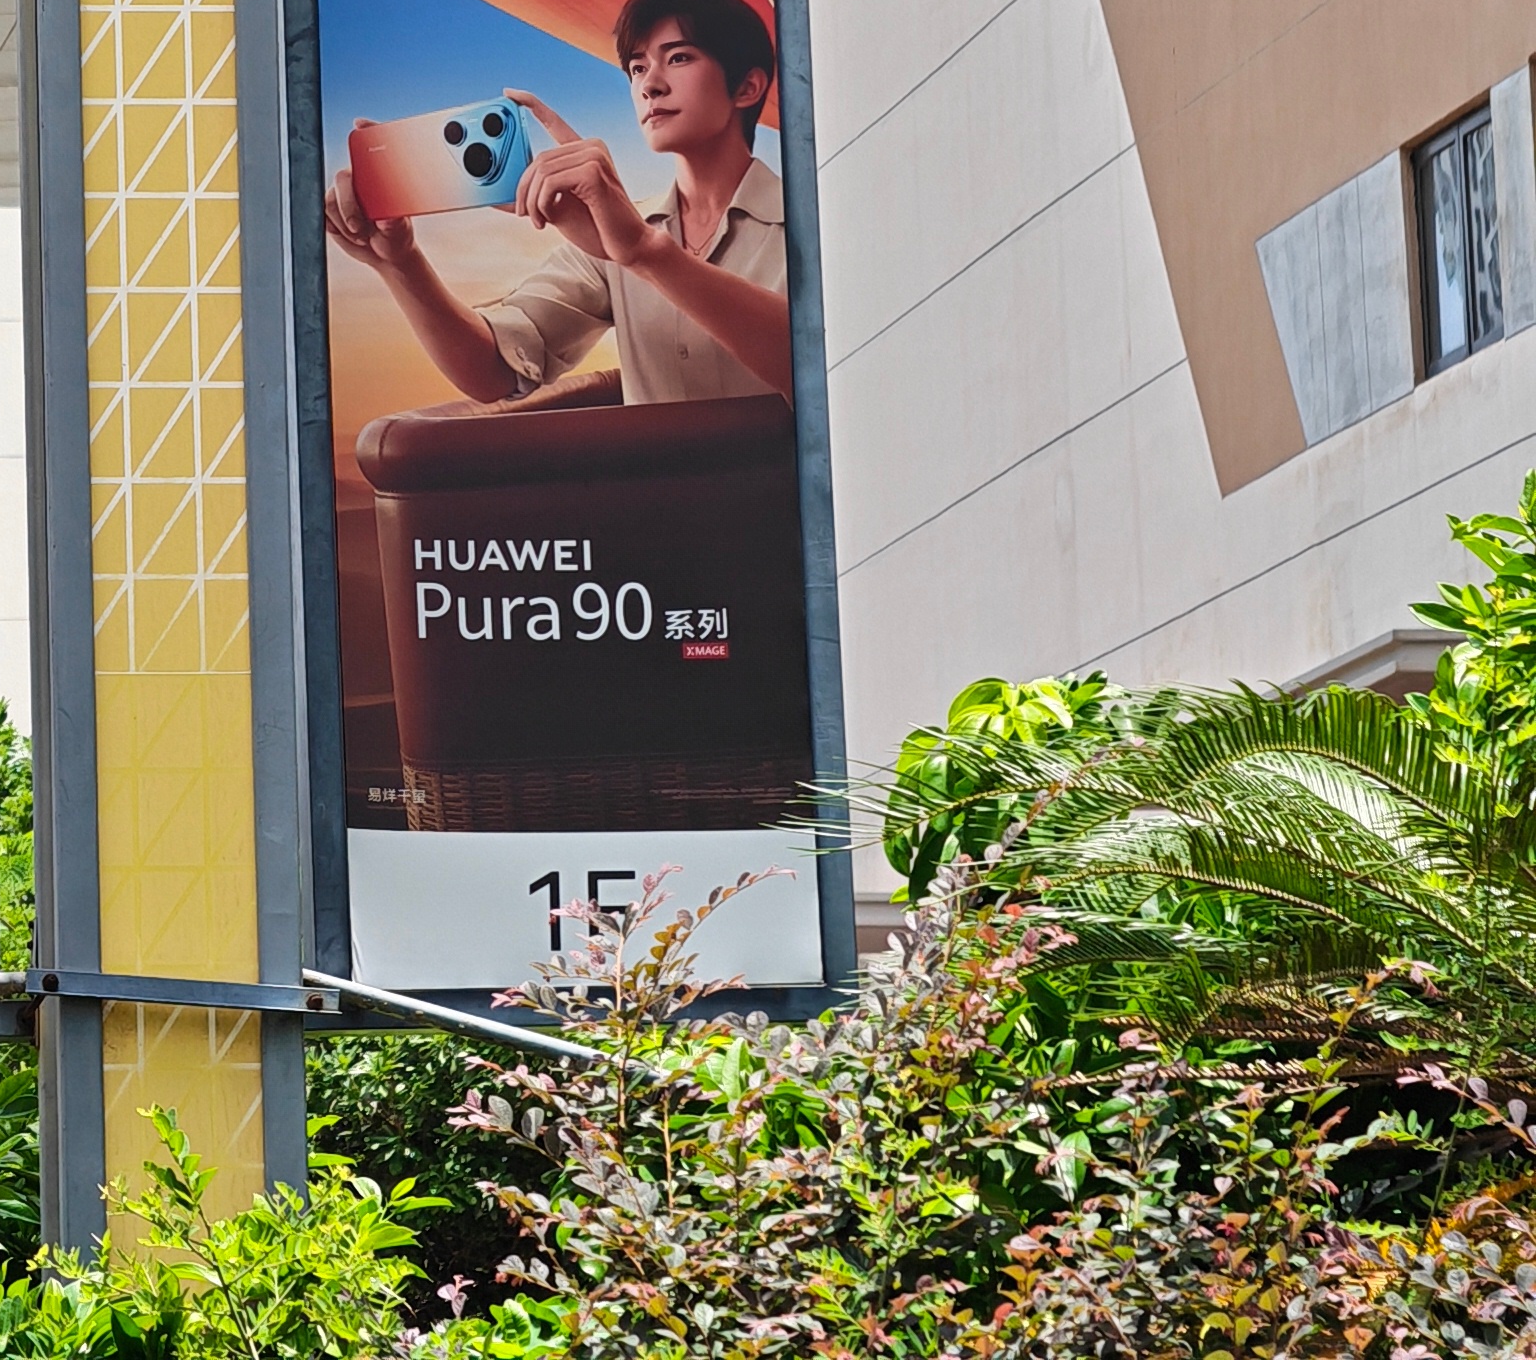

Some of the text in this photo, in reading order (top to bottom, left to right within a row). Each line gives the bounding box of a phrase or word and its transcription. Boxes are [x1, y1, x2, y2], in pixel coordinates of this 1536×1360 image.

[414, 539, 592, 571] HUAWEI
[664, 607, 728, 640] 系列
[686, 646, 726, 656] XMAGE
[528, 870, 636, 952] 1F
